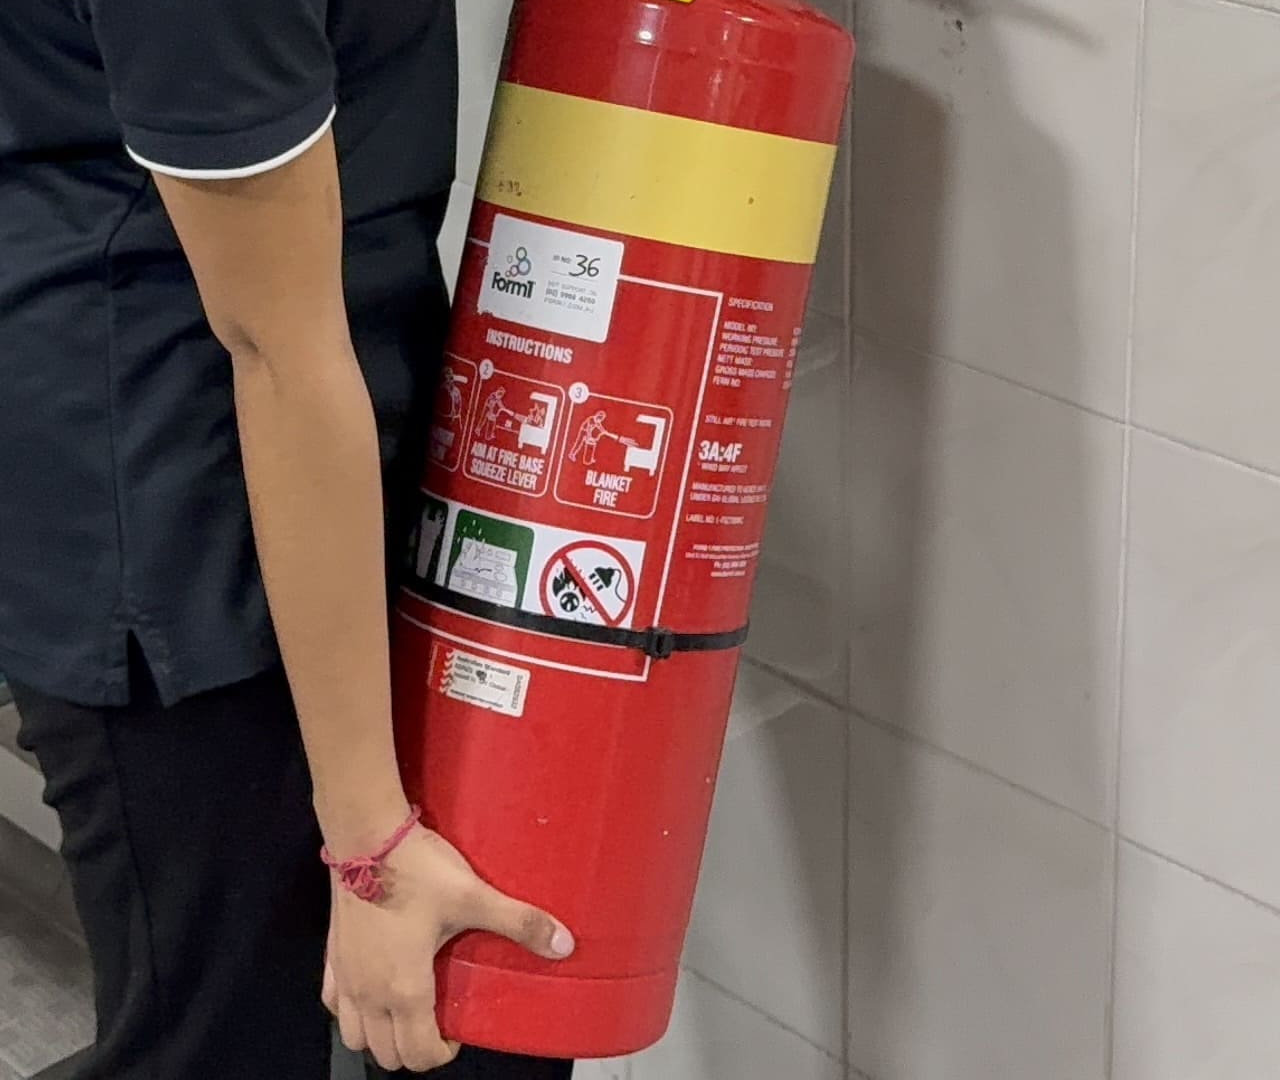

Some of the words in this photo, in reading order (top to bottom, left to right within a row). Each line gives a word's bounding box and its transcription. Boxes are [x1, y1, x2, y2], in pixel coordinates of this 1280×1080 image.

[569, 254, 601, 277] 36
[486, 329, 573, 364] INSTRUCTIONS
[483, 363, 489, 375] 2
[574, 386, 583, 399] 3
[486, 448, 497, 460] AT
[498, 450, 518, 468] FIRE
[519, 455, 545, 474] BASE
[699, 440, 743, 463] 3A:4F
[471, 460, 506, 480] SQUEEZE
[507, 469, 538, 490] LEVER
[585, 470, 632, 492] BLANKET
[593, 489, 617, 507] FIRE
